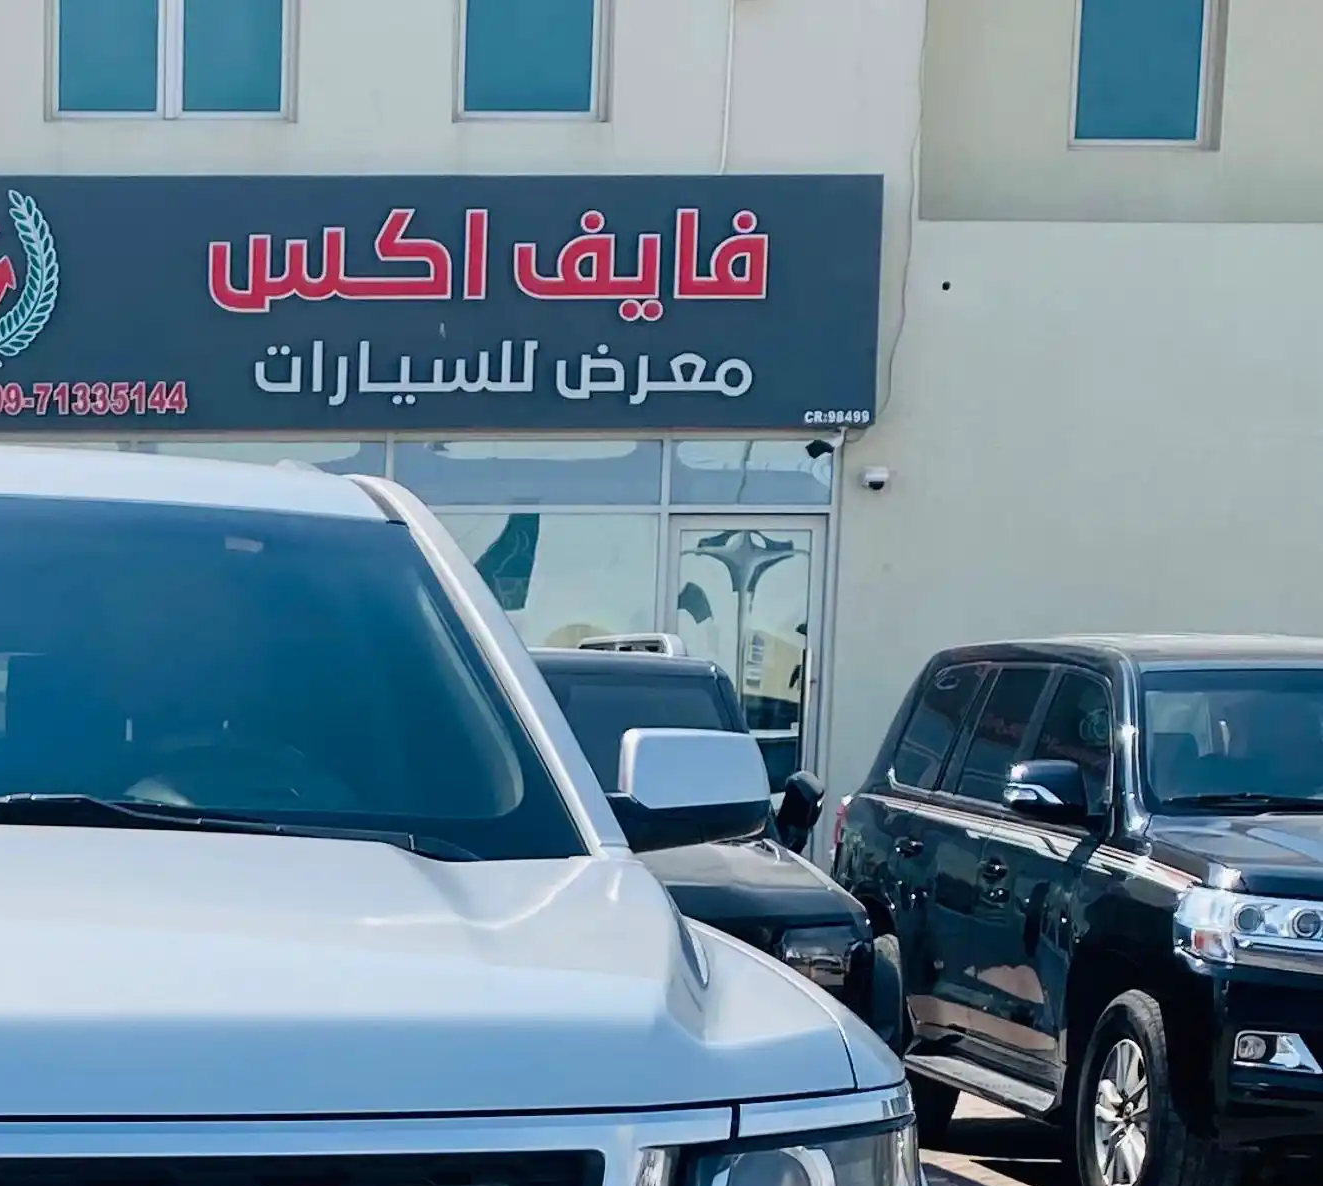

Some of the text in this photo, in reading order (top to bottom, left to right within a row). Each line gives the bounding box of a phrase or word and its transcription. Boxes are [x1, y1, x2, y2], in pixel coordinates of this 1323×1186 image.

[208, 209, 769, 321] فايف اكس
[254, 340, 754, 405] معرض للسيارات
